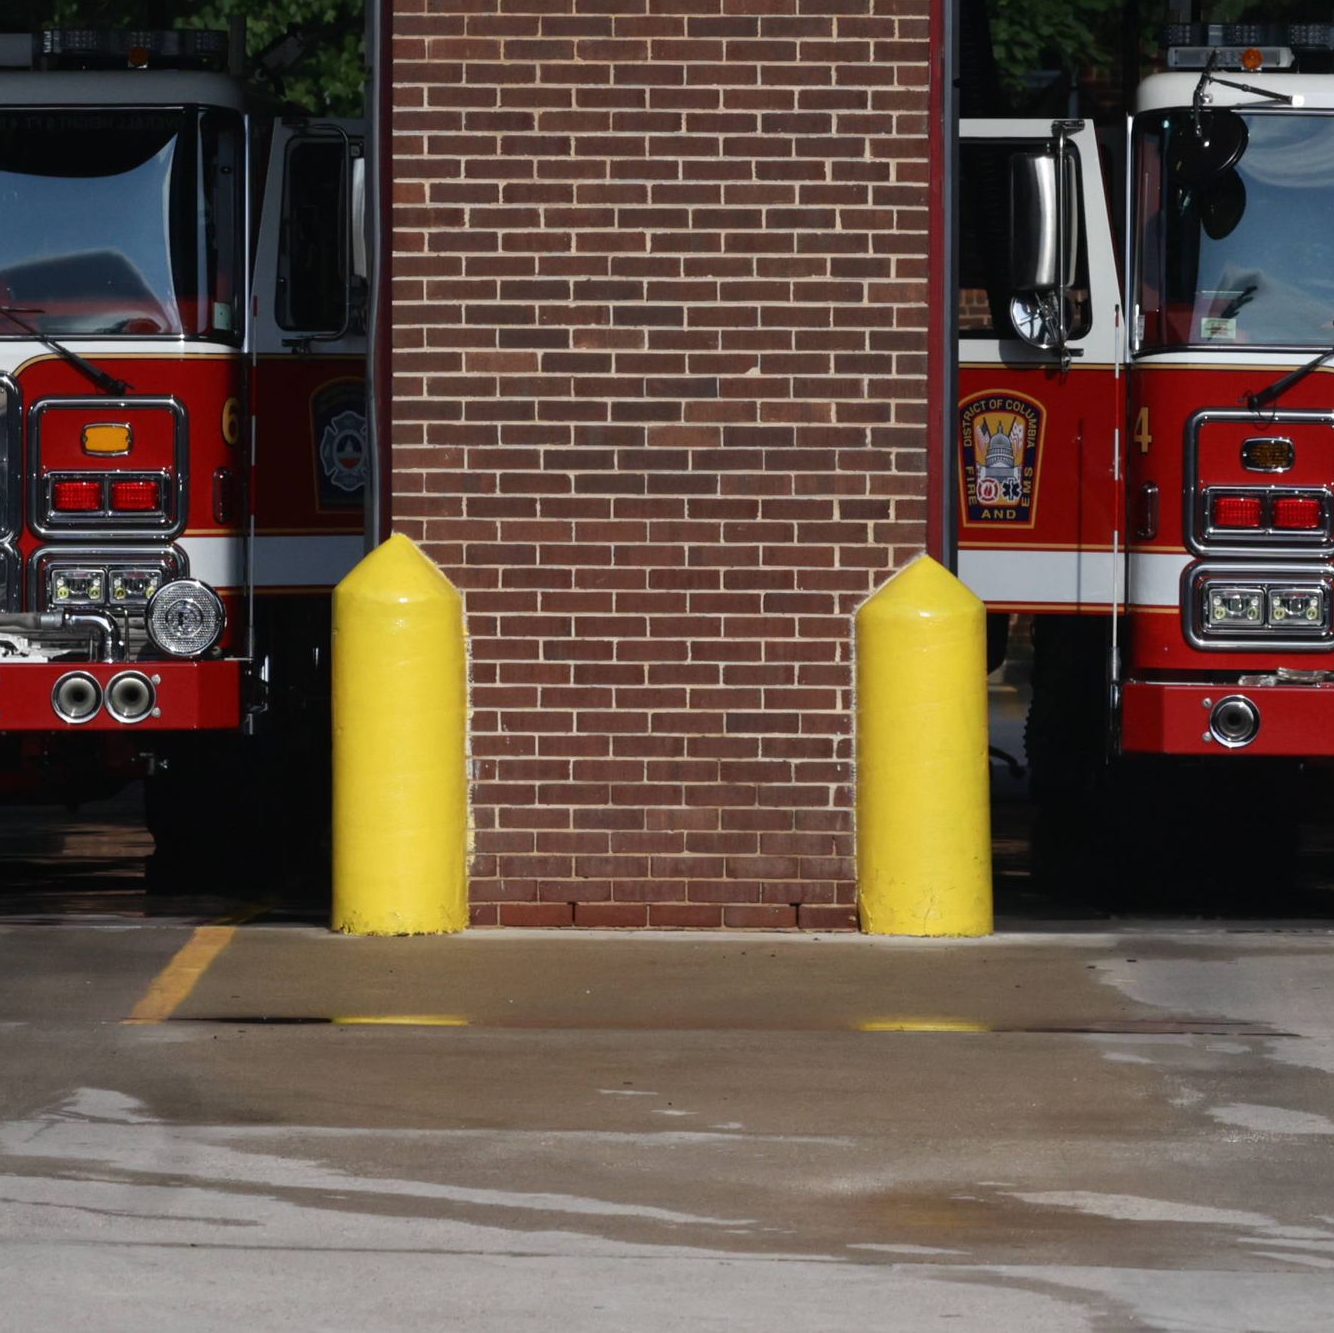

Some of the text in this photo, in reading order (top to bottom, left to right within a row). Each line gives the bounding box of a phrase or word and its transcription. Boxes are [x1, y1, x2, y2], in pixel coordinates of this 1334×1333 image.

[222, 395, 240, 445] 6
[962, 398, 1037, 448] DISTRICT OF COLUMBIA
[1134, 406, 1153, 454] 4
[965, 466, 978, 506] FIRE
[1021, 466, 1034, 508] EMS
[981, 509, 1017, 519] AND
